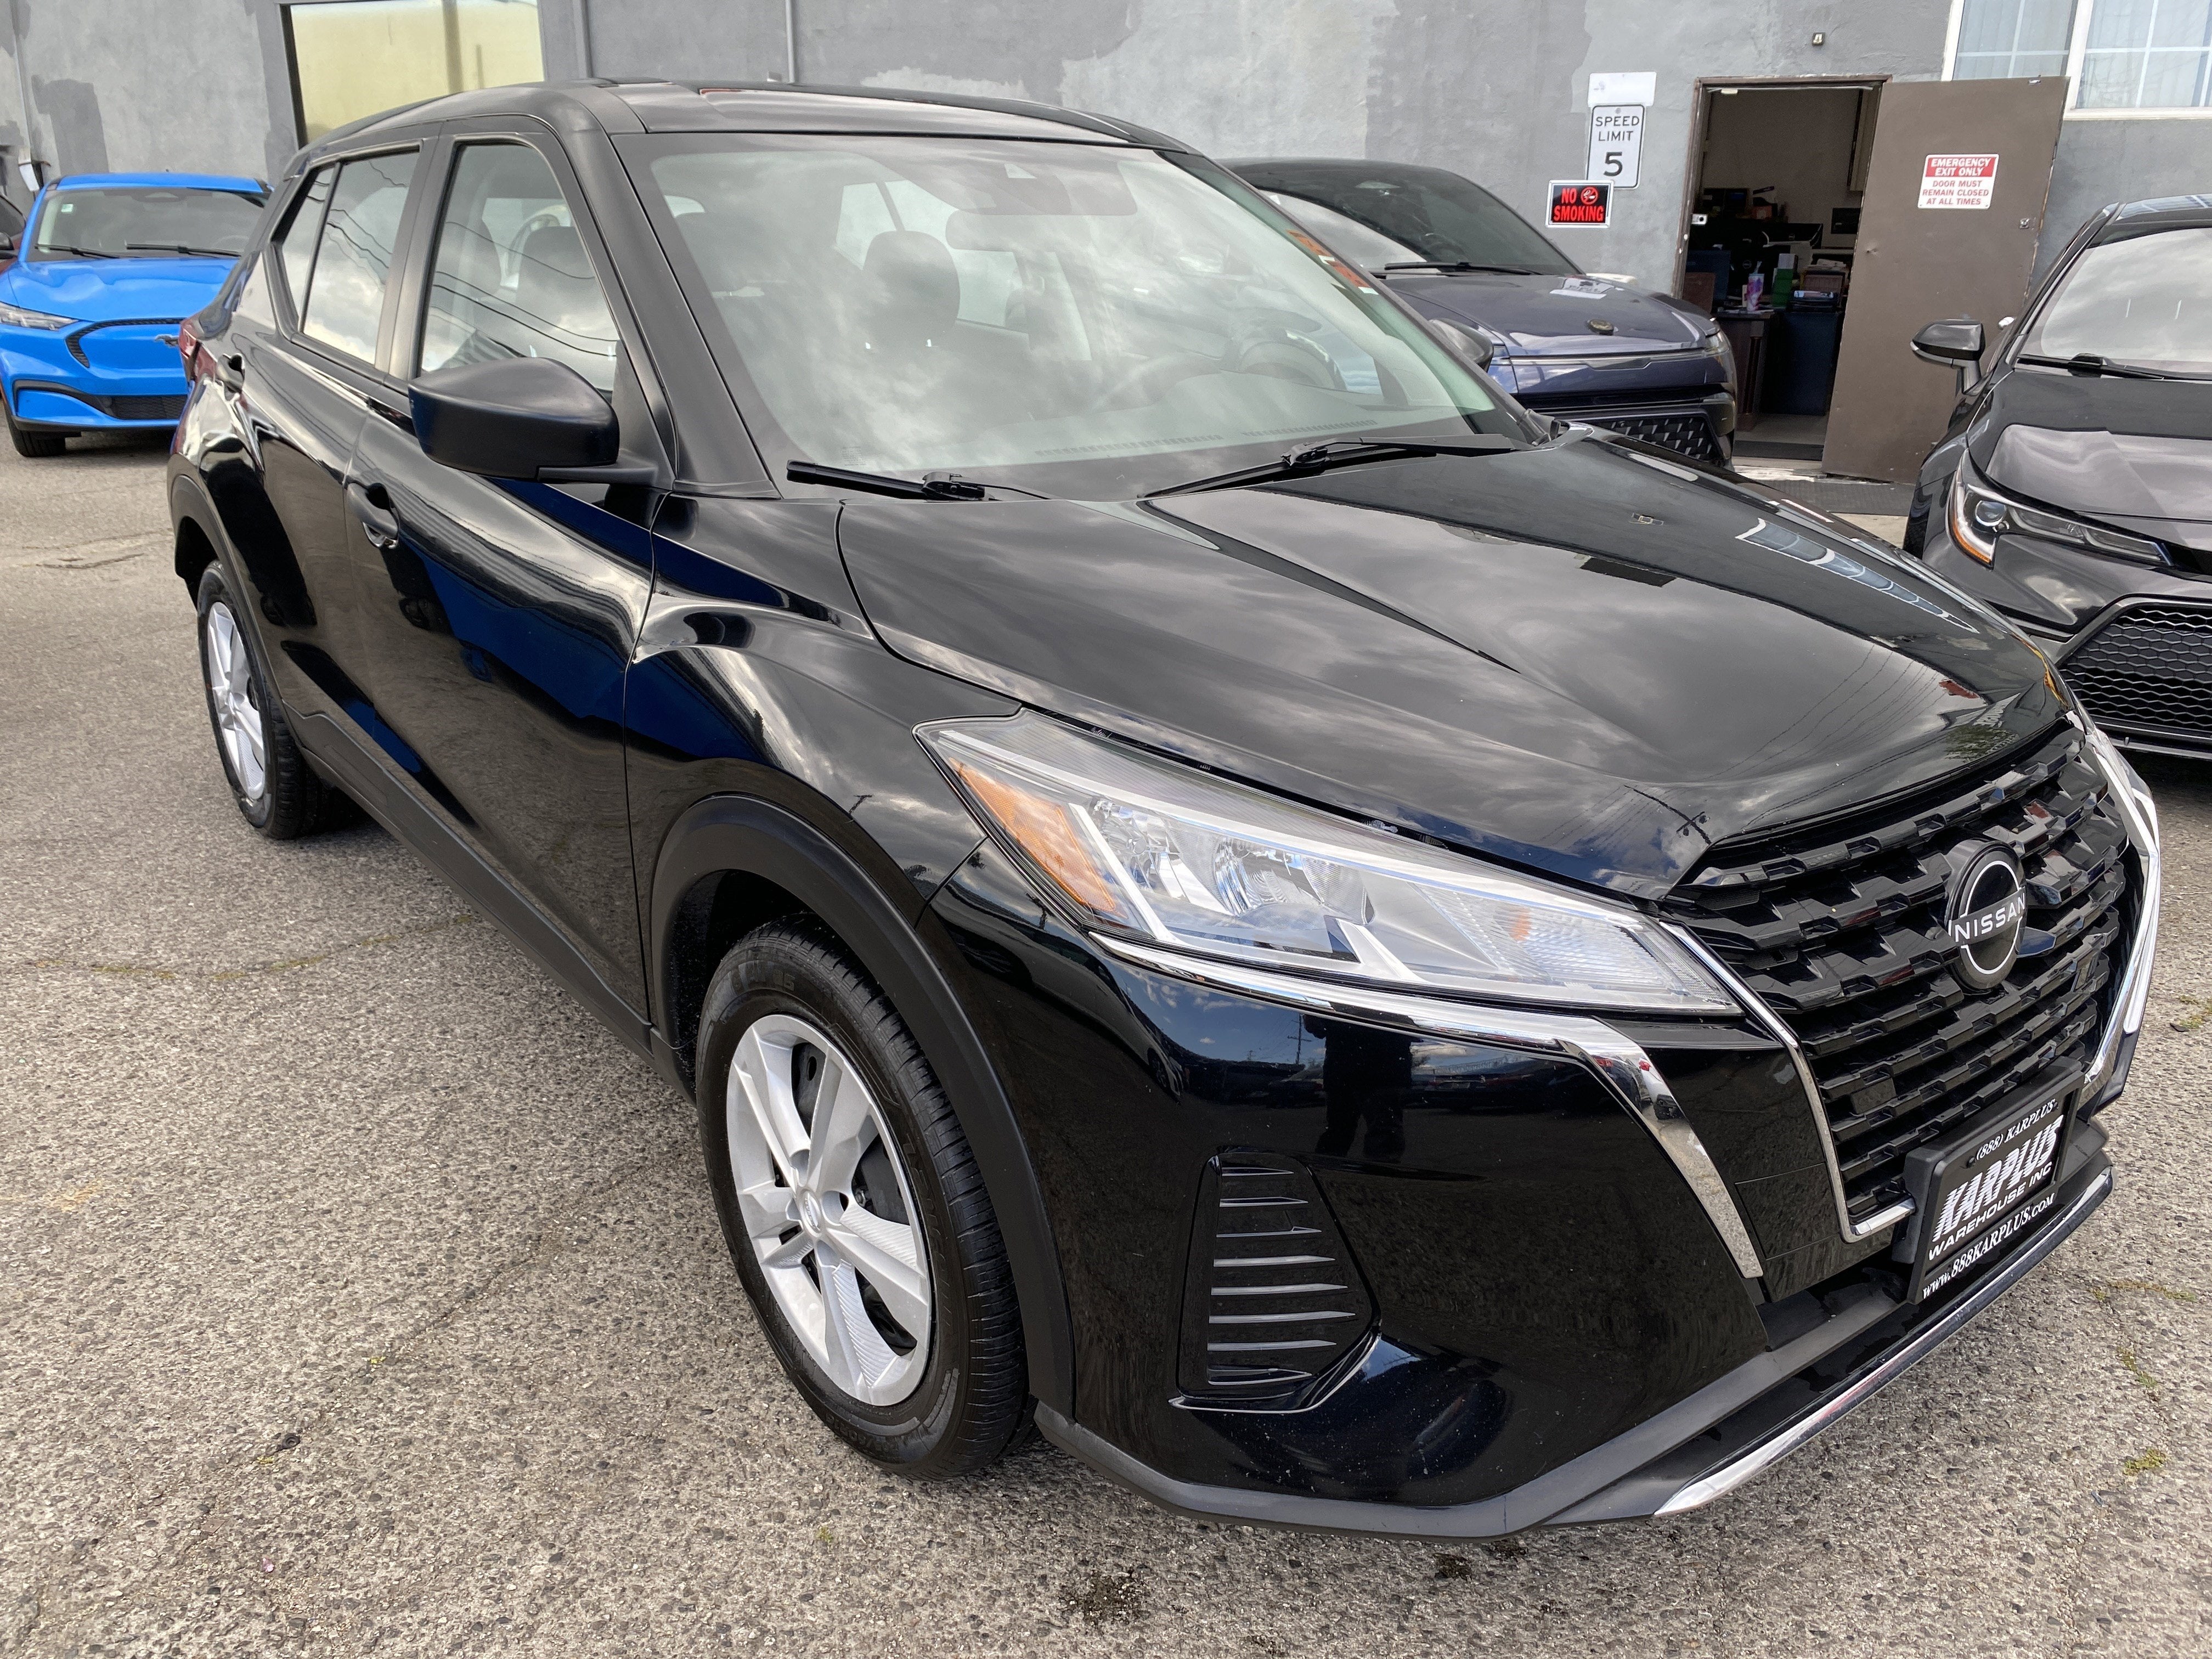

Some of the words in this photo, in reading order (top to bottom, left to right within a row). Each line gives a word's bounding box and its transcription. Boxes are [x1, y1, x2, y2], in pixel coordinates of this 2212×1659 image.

[1595, 116, 1639, 127] SPEED
[1598, 131, 1634, 142] LIMIT
[1603, 151, 1623, 177] 5
[1931, 157, 1991, 167] EMERGENCY
[1934, 167, 1957, 176] EXIT
[1959, 167, 1984, 176] ONLY
[1561, 188, 1577, 204] NO
[1554, 205, 1604, 222] SMOKING
[1955, 893, 2025, 943] NISSAN
[1976, 1133, 2004, 1161] (888)
[2004, 1098, 2056, 1143] KARPLUS
[1932, 1114, 2064, 1243] KARPLUS
[1928, 1182, 2027, 1261] WAREHOUSE
[2029, 1161, 2052, 1188] INC
